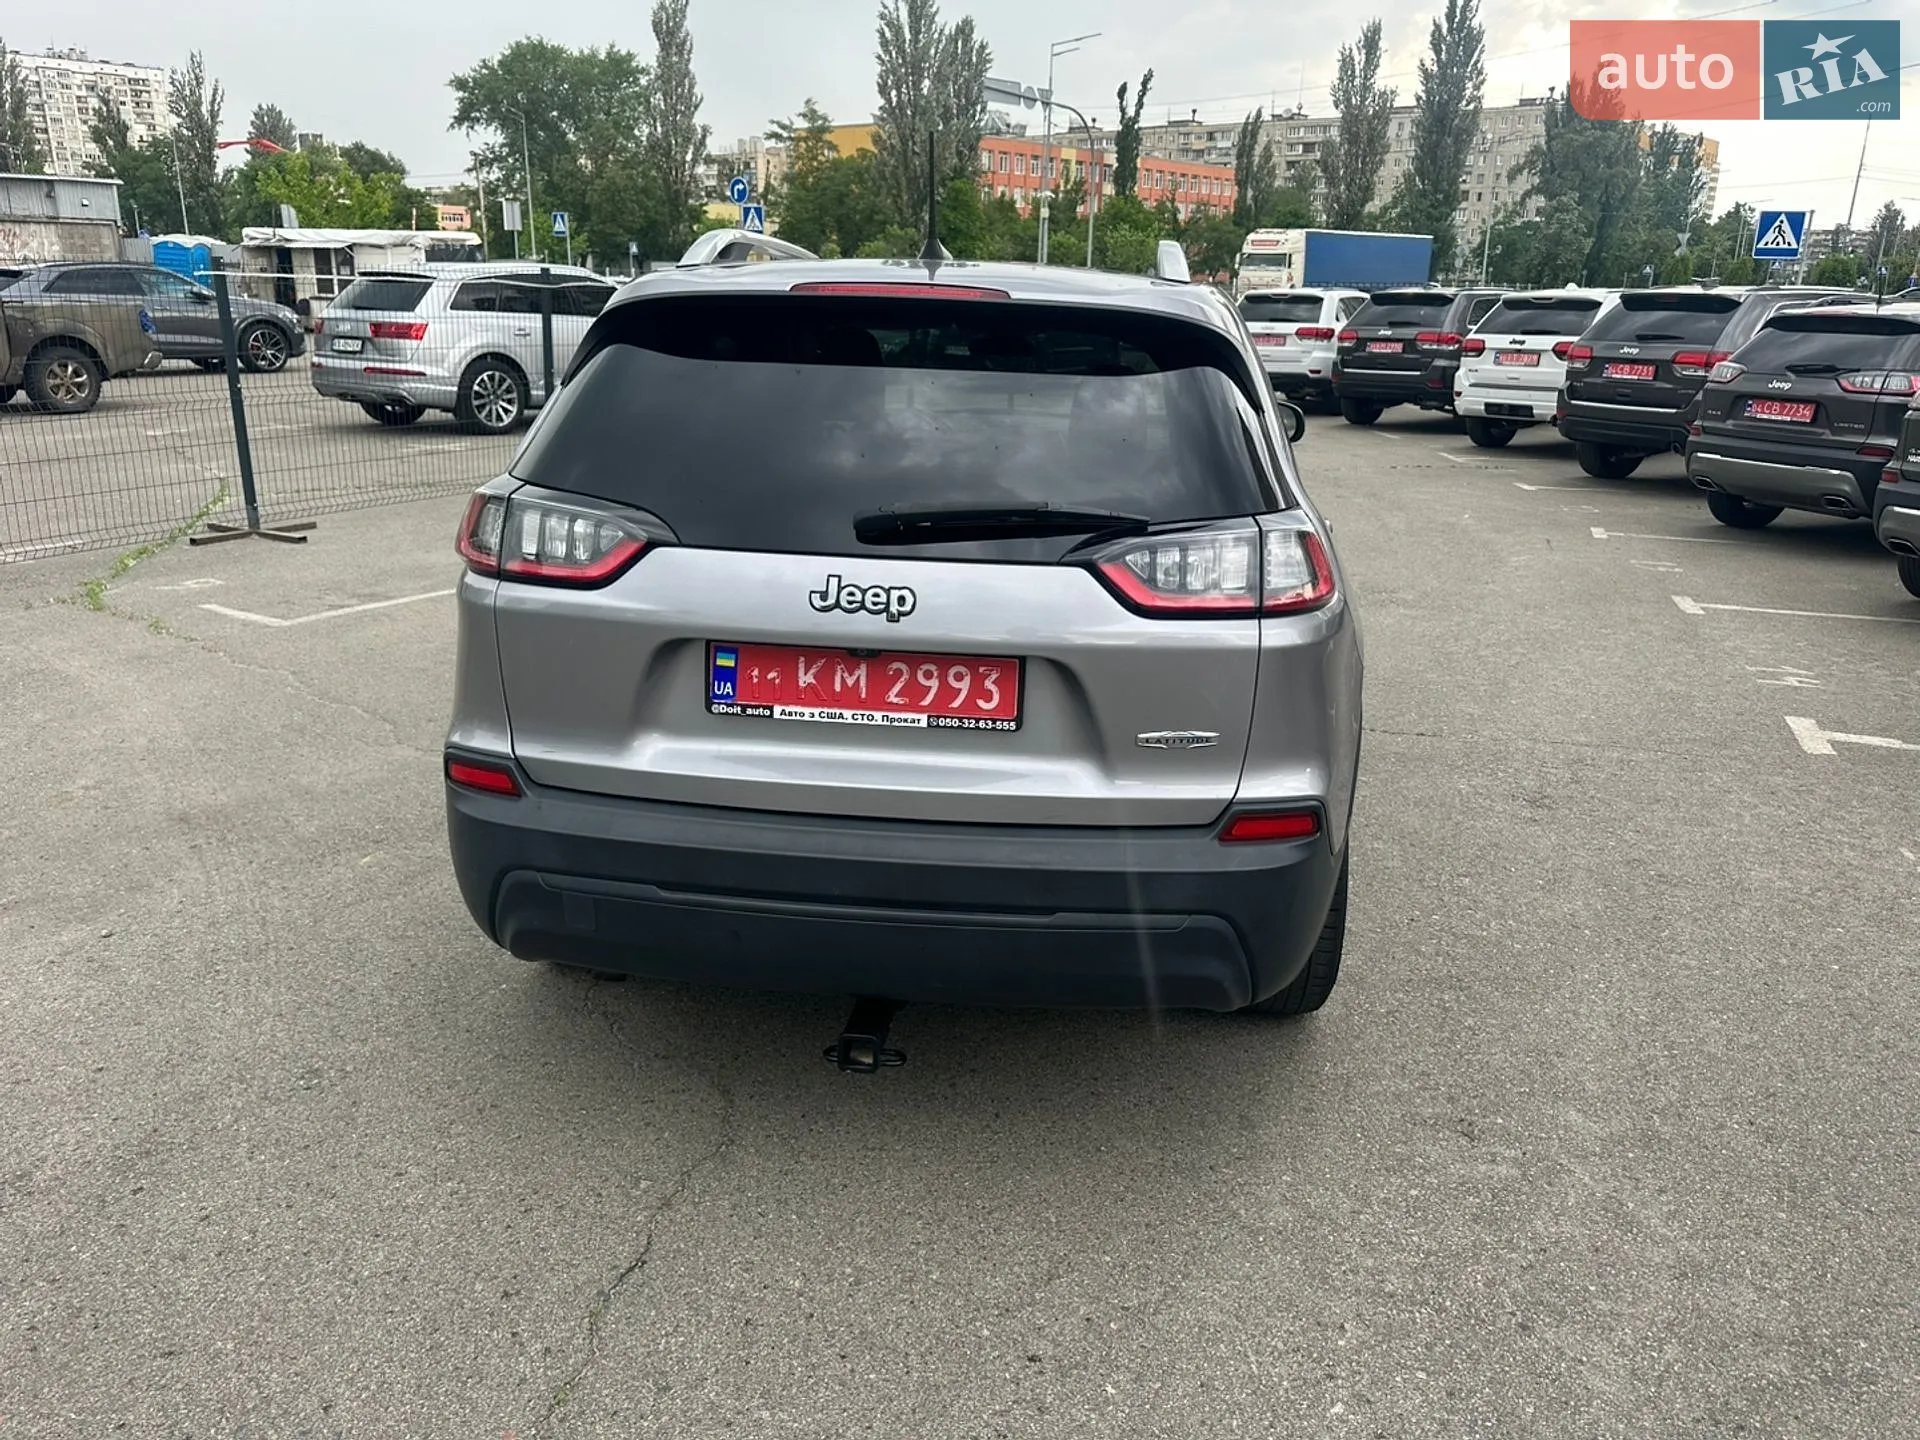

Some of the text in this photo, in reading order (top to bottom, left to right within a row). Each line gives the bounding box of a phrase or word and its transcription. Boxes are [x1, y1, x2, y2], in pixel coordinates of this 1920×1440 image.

[1620, 346, 1639, 355] Jeep
[1768, 379, 1792, 391] Jeep
[1763, 401, 1780, 414] CB
[1782, 403, 1810, 417] 7734
[809, 574, 916, 622] Jeep
[713, 681, 734, 696] UA
[797, 656, 867, 701] KM
[884, 662, 1001, 711] 2993
[779, 708, 805, 718] Авто
[881, 714, 921, 725] Прокат
